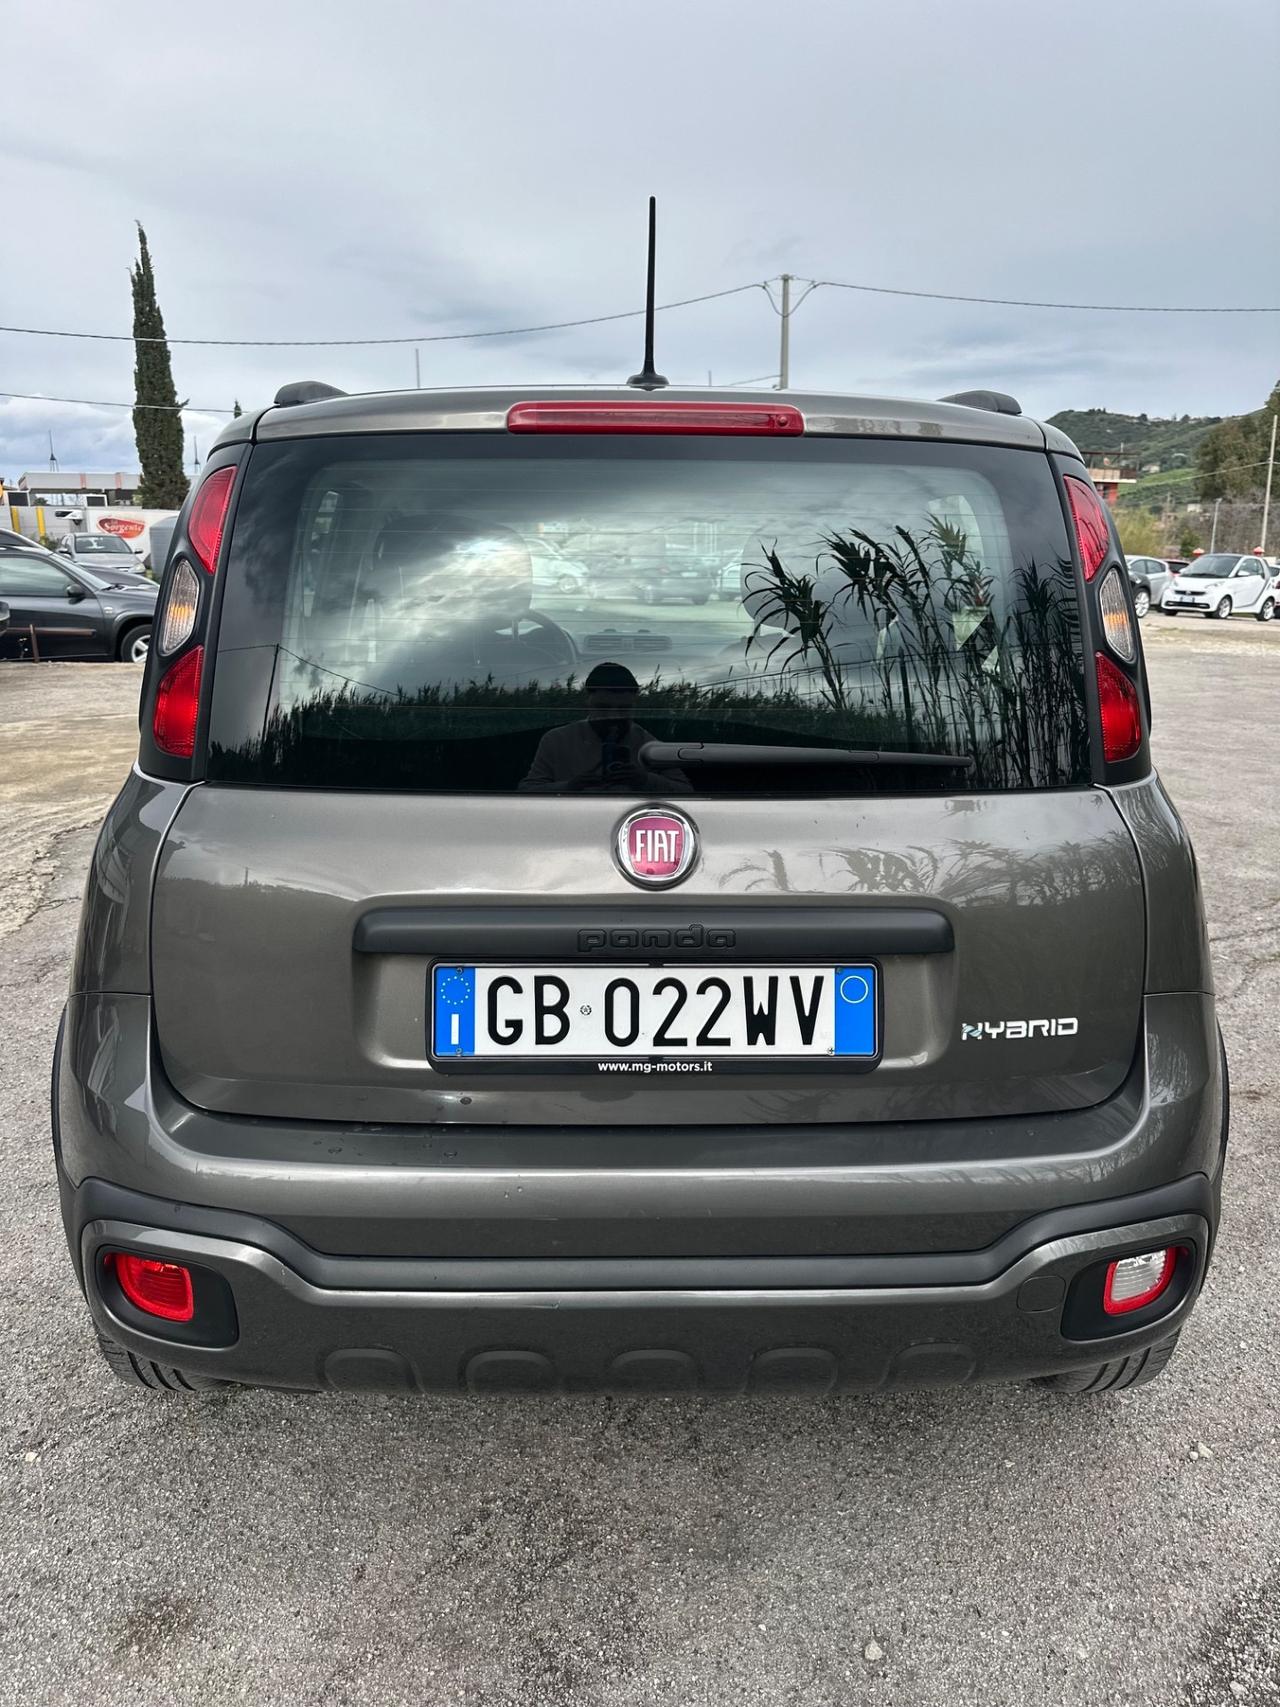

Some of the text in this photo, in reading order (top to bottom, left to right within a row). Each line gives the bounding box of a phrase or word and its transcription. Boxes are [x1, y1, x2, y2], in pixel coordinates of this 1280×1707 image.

[636, 830, 680, 862] FIAT
[577, 924, 736, 952] panda
[487, 976, 824, 1047] GB 022WV
[962, 1017, 1078, 1040] HYBRID
[598, 1061, 712, 1073] www.mg-motors.it
